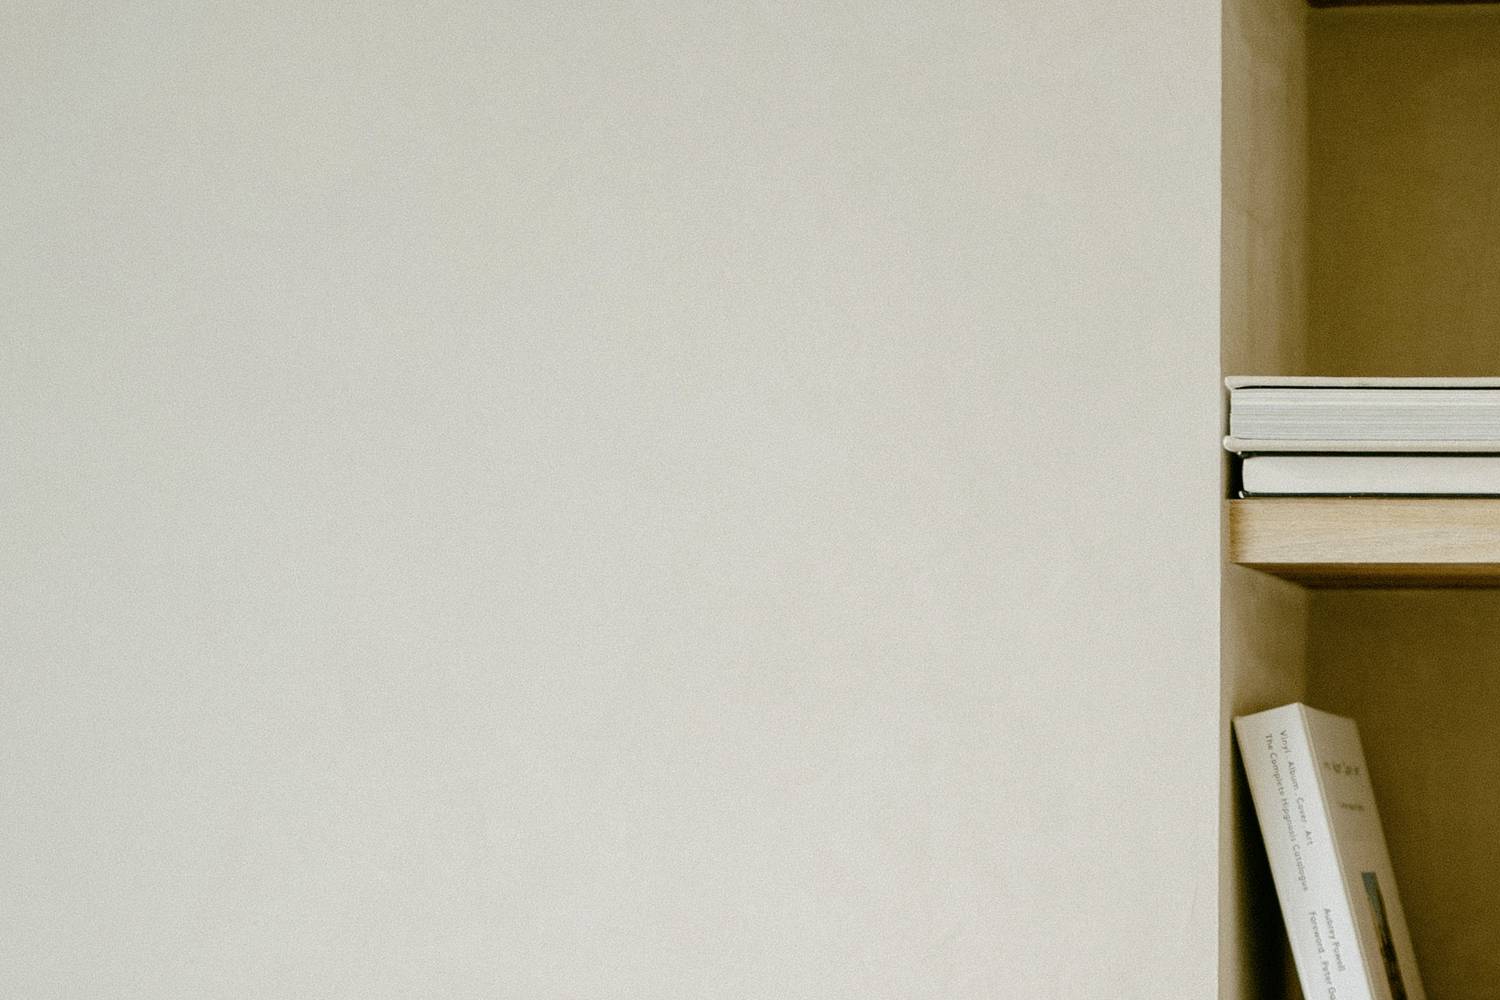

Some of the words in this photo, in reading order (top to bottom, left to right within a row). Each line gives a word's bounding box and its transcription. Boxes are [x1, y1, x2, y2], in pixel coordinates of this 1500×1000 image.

[1265, 733, 1273, 750] The
[1280, 729, 1291, 753] Vinyl
[1288, 761, 1299, 790] Album
[1296, 797, 1307, 823] Cover
[1305, 830, 1313, 846] Art
